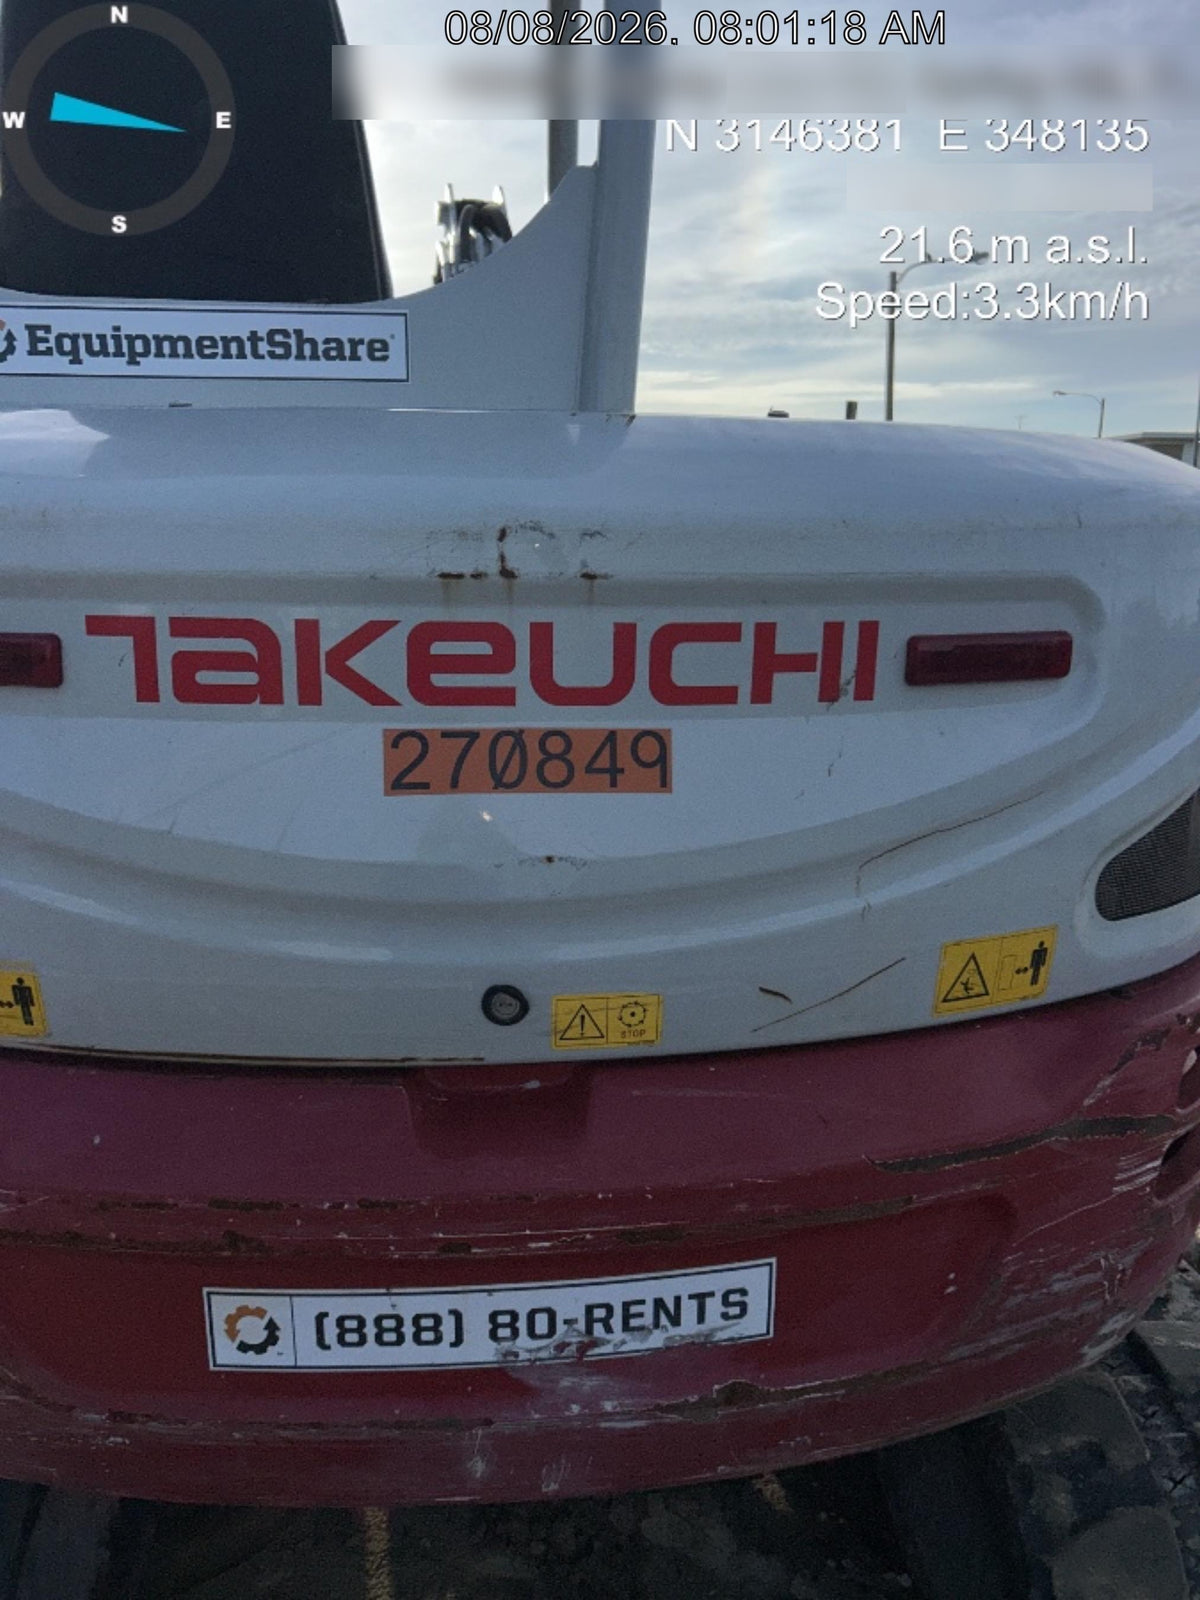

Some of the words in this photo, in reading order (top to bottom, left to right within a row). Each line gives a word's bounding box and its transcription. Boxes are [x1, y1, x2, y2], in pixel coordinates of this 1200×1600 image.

[25, 324, 390, 366] EquipmentShare
[390, 730, 667, 790] 270849
[620, 1029, 646, 1038] STOP
[314, 1311, 464, 1349] (888)
[488, 1288, 748, 1341] 80-RENTS
